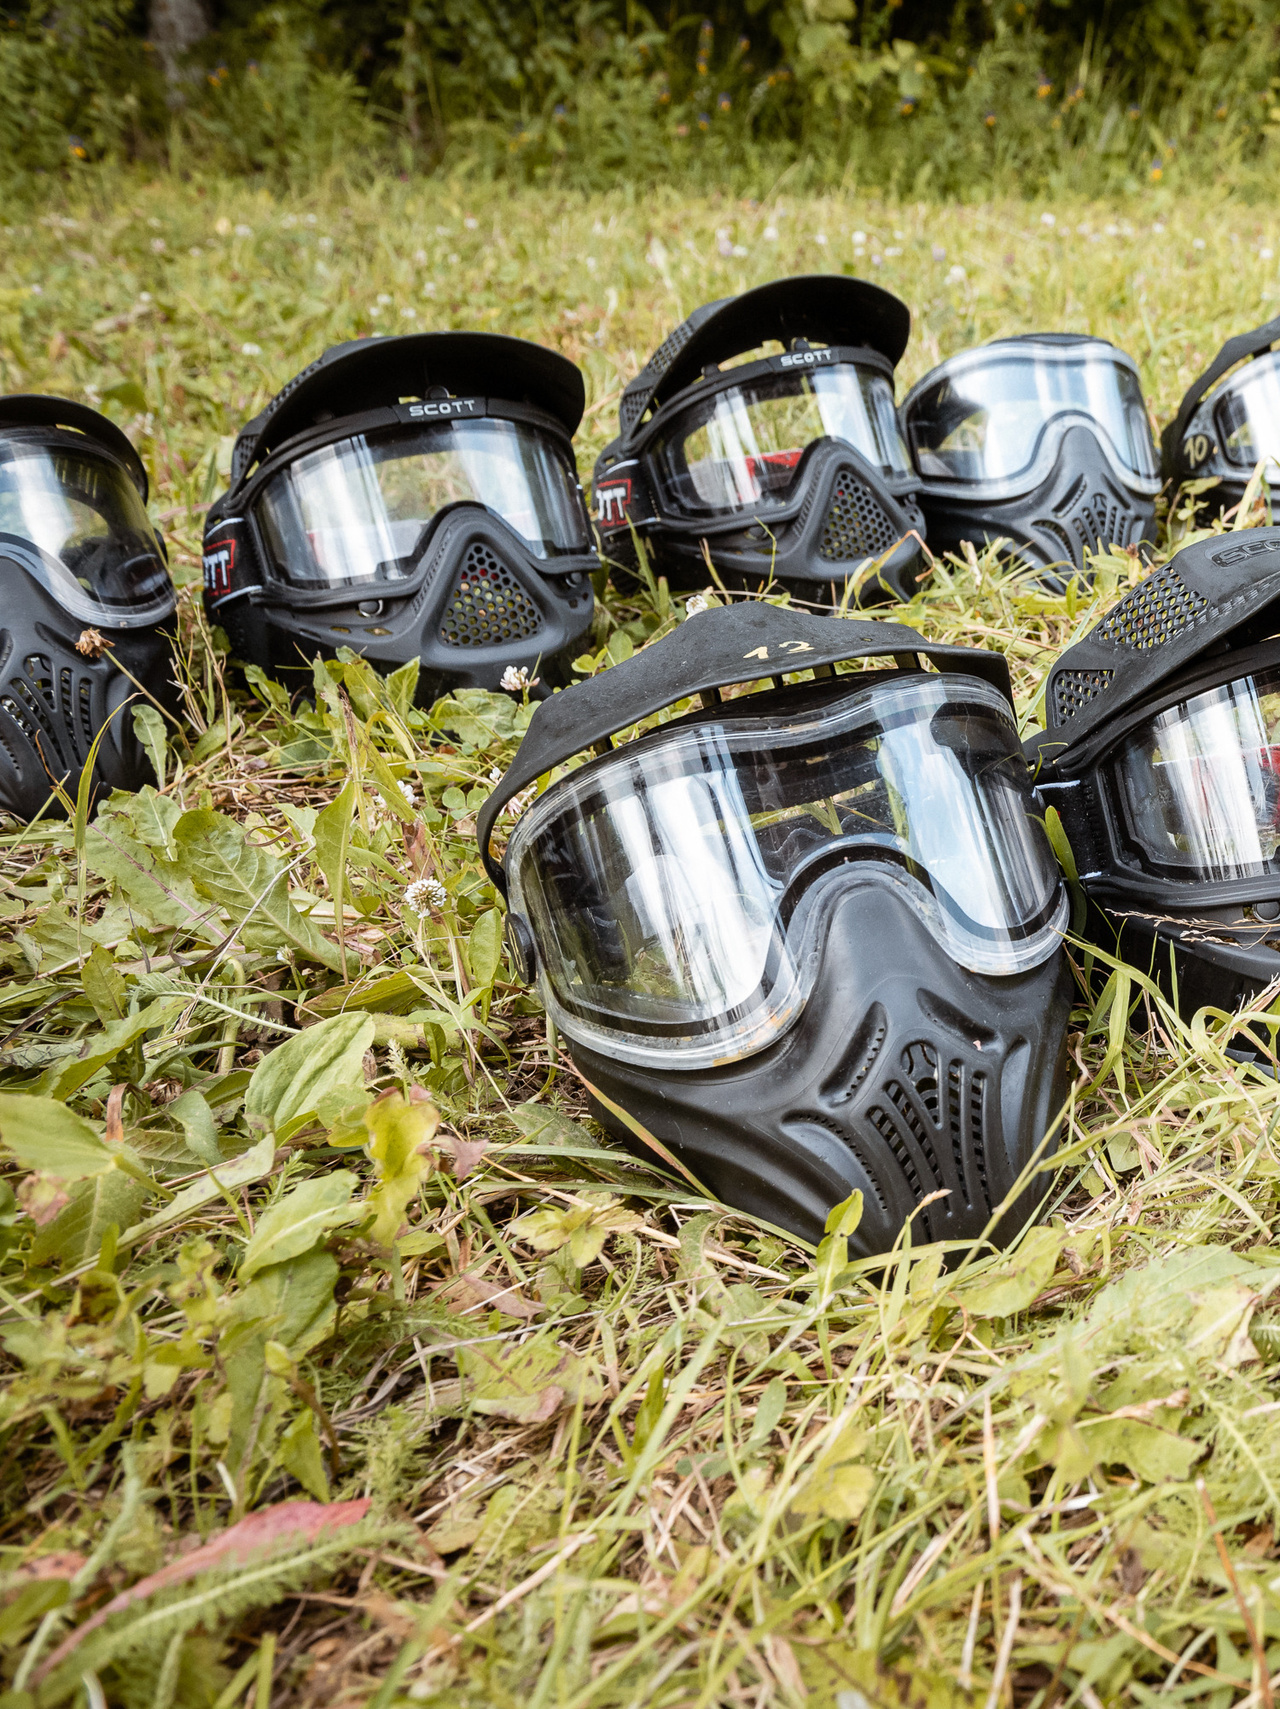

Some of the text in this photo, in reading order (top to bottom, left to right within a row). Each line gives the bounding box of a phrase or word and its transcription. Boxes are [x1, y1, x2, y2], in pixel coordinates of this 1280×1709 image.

[780, 349, 832, 367] SCOTT
[409, 399, 475, 417] SCOTT
[1183, 434, 1208, 470] 10
